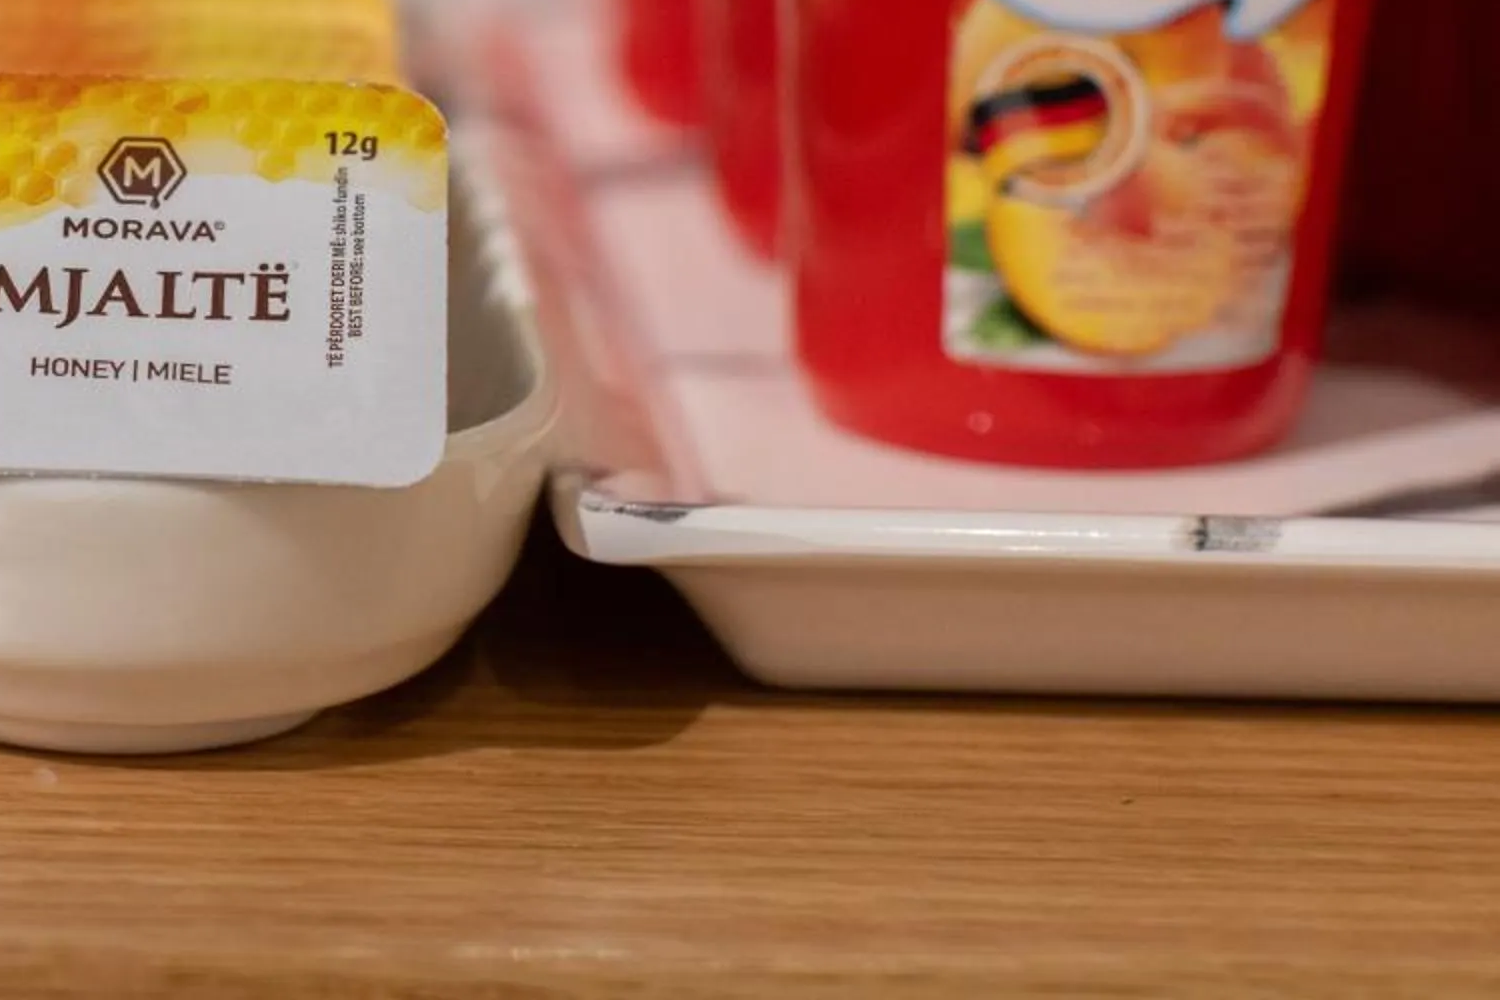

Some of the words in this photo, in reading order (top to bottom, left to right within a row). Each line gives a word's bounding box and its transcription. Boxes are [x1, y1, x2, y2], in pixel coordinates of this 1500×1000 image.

[324, 131, 378, 160] 12g
[332, 204, 347, 234] shiko
[350, 192, 365, 235] bottom
[348, 256, 363, 305] BEFORE:
[347, 308, 363, 337] BEST
[30, 356, 125, 381] HONEY
[147, 360, 232, 386] MIELE
